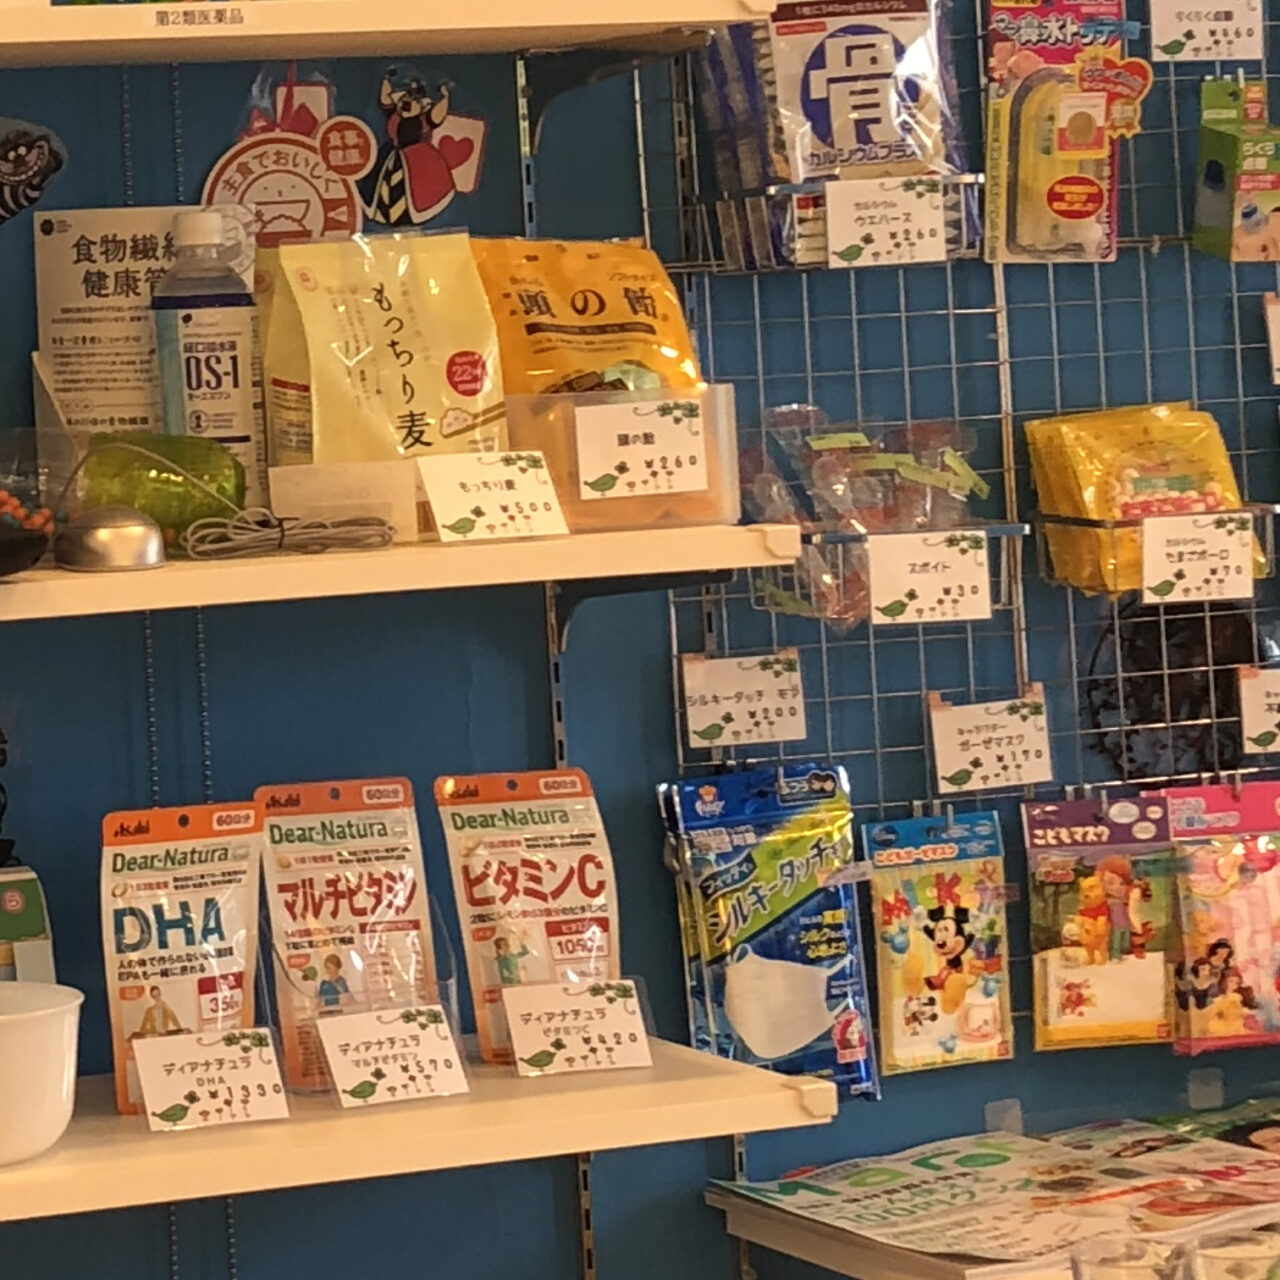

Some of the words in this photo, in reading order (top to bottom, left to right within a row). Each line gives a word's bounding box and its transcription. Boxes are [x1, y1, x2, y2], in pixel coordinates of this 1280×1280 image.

[155, 7, 245, 27] 第2類医薬品
[184, 354, 241, 391] OS-1
[370, 281, 438, 453] もっちり麦
[450, 808, 570, 832] Dear-Natura
[269, 818, 389, 847] Dear-Natura
[1032, 825, 1111, 845] こどもマスク
[112, 845, 230, 875] Dear-Natura
[460, 852, 608, 907] ビタミンC
[112, 896, 227, 956] DHA
[519, 1007, 607, 1026] ディアナチュラ
[337, 1034, 421, 1057] ディアナチュラ
[161, 1055, 252, 1077] ディアナチュラ
[195, 1075, 227, 1088] DHA
